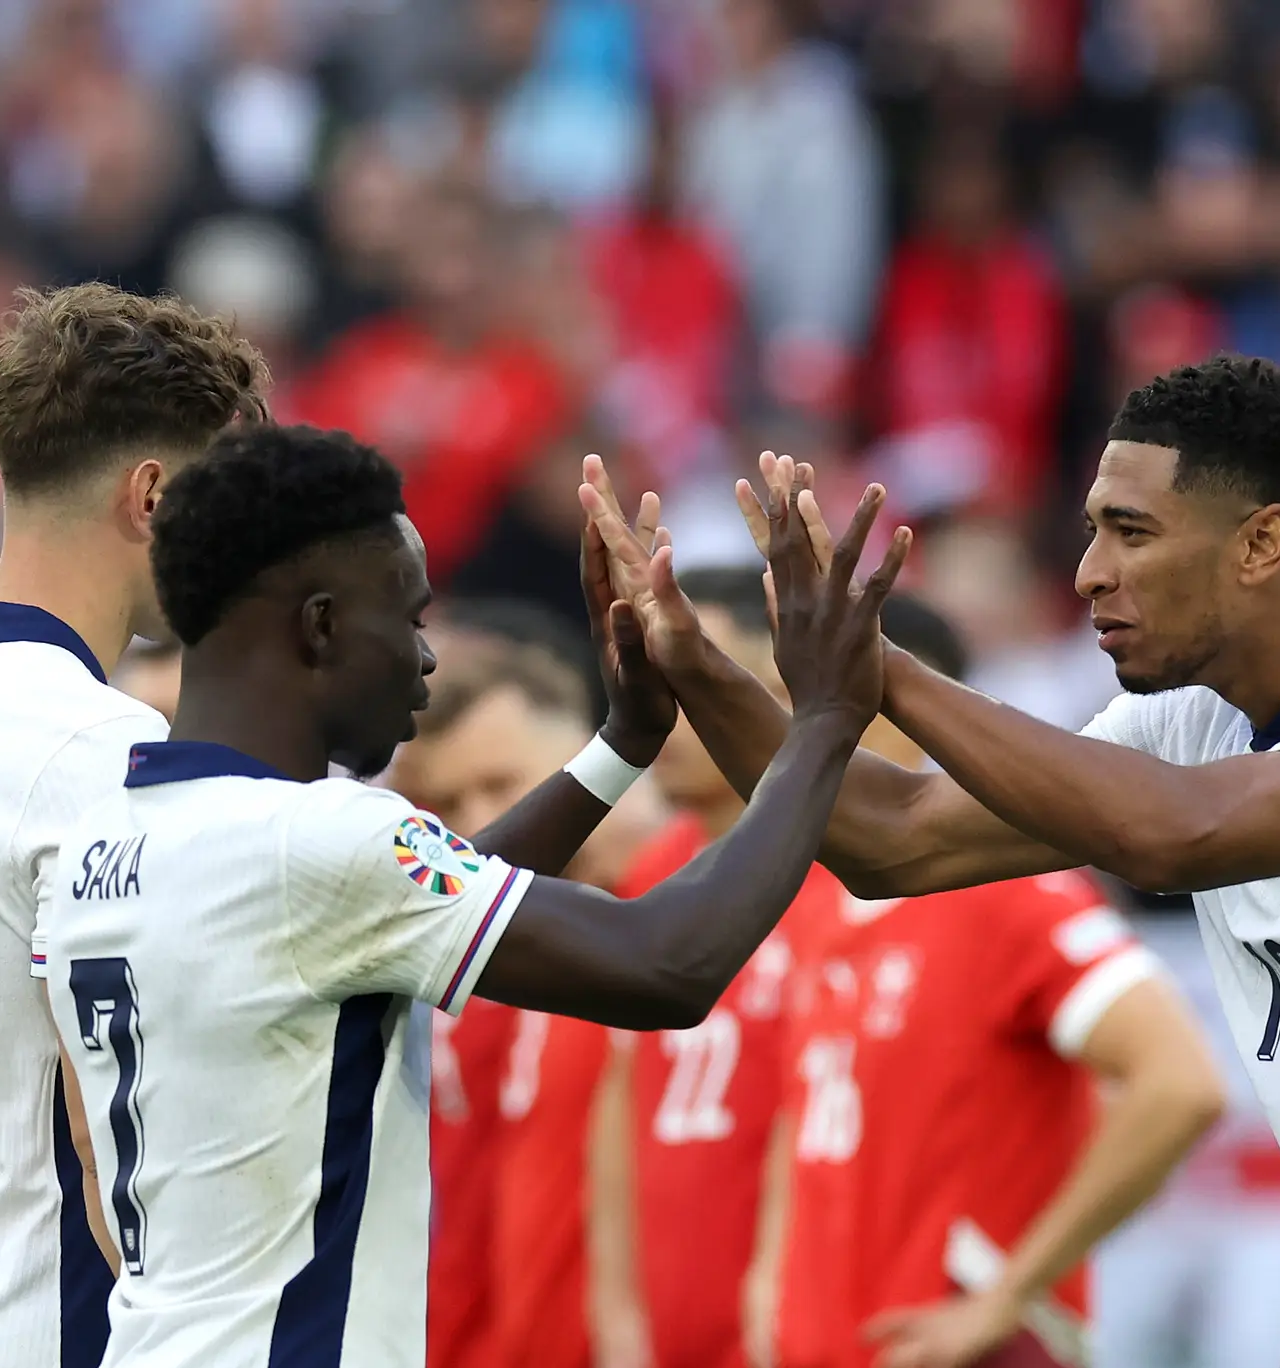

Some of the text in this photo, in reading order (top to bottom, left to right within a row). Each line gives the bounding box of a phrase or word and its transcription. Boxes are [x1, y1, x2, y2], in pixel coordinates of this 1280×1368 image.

[72, 832, 148, 900] SAKA
[69, 957, 148, 1276] 7
[652, 1008, 741, 1146] 22
